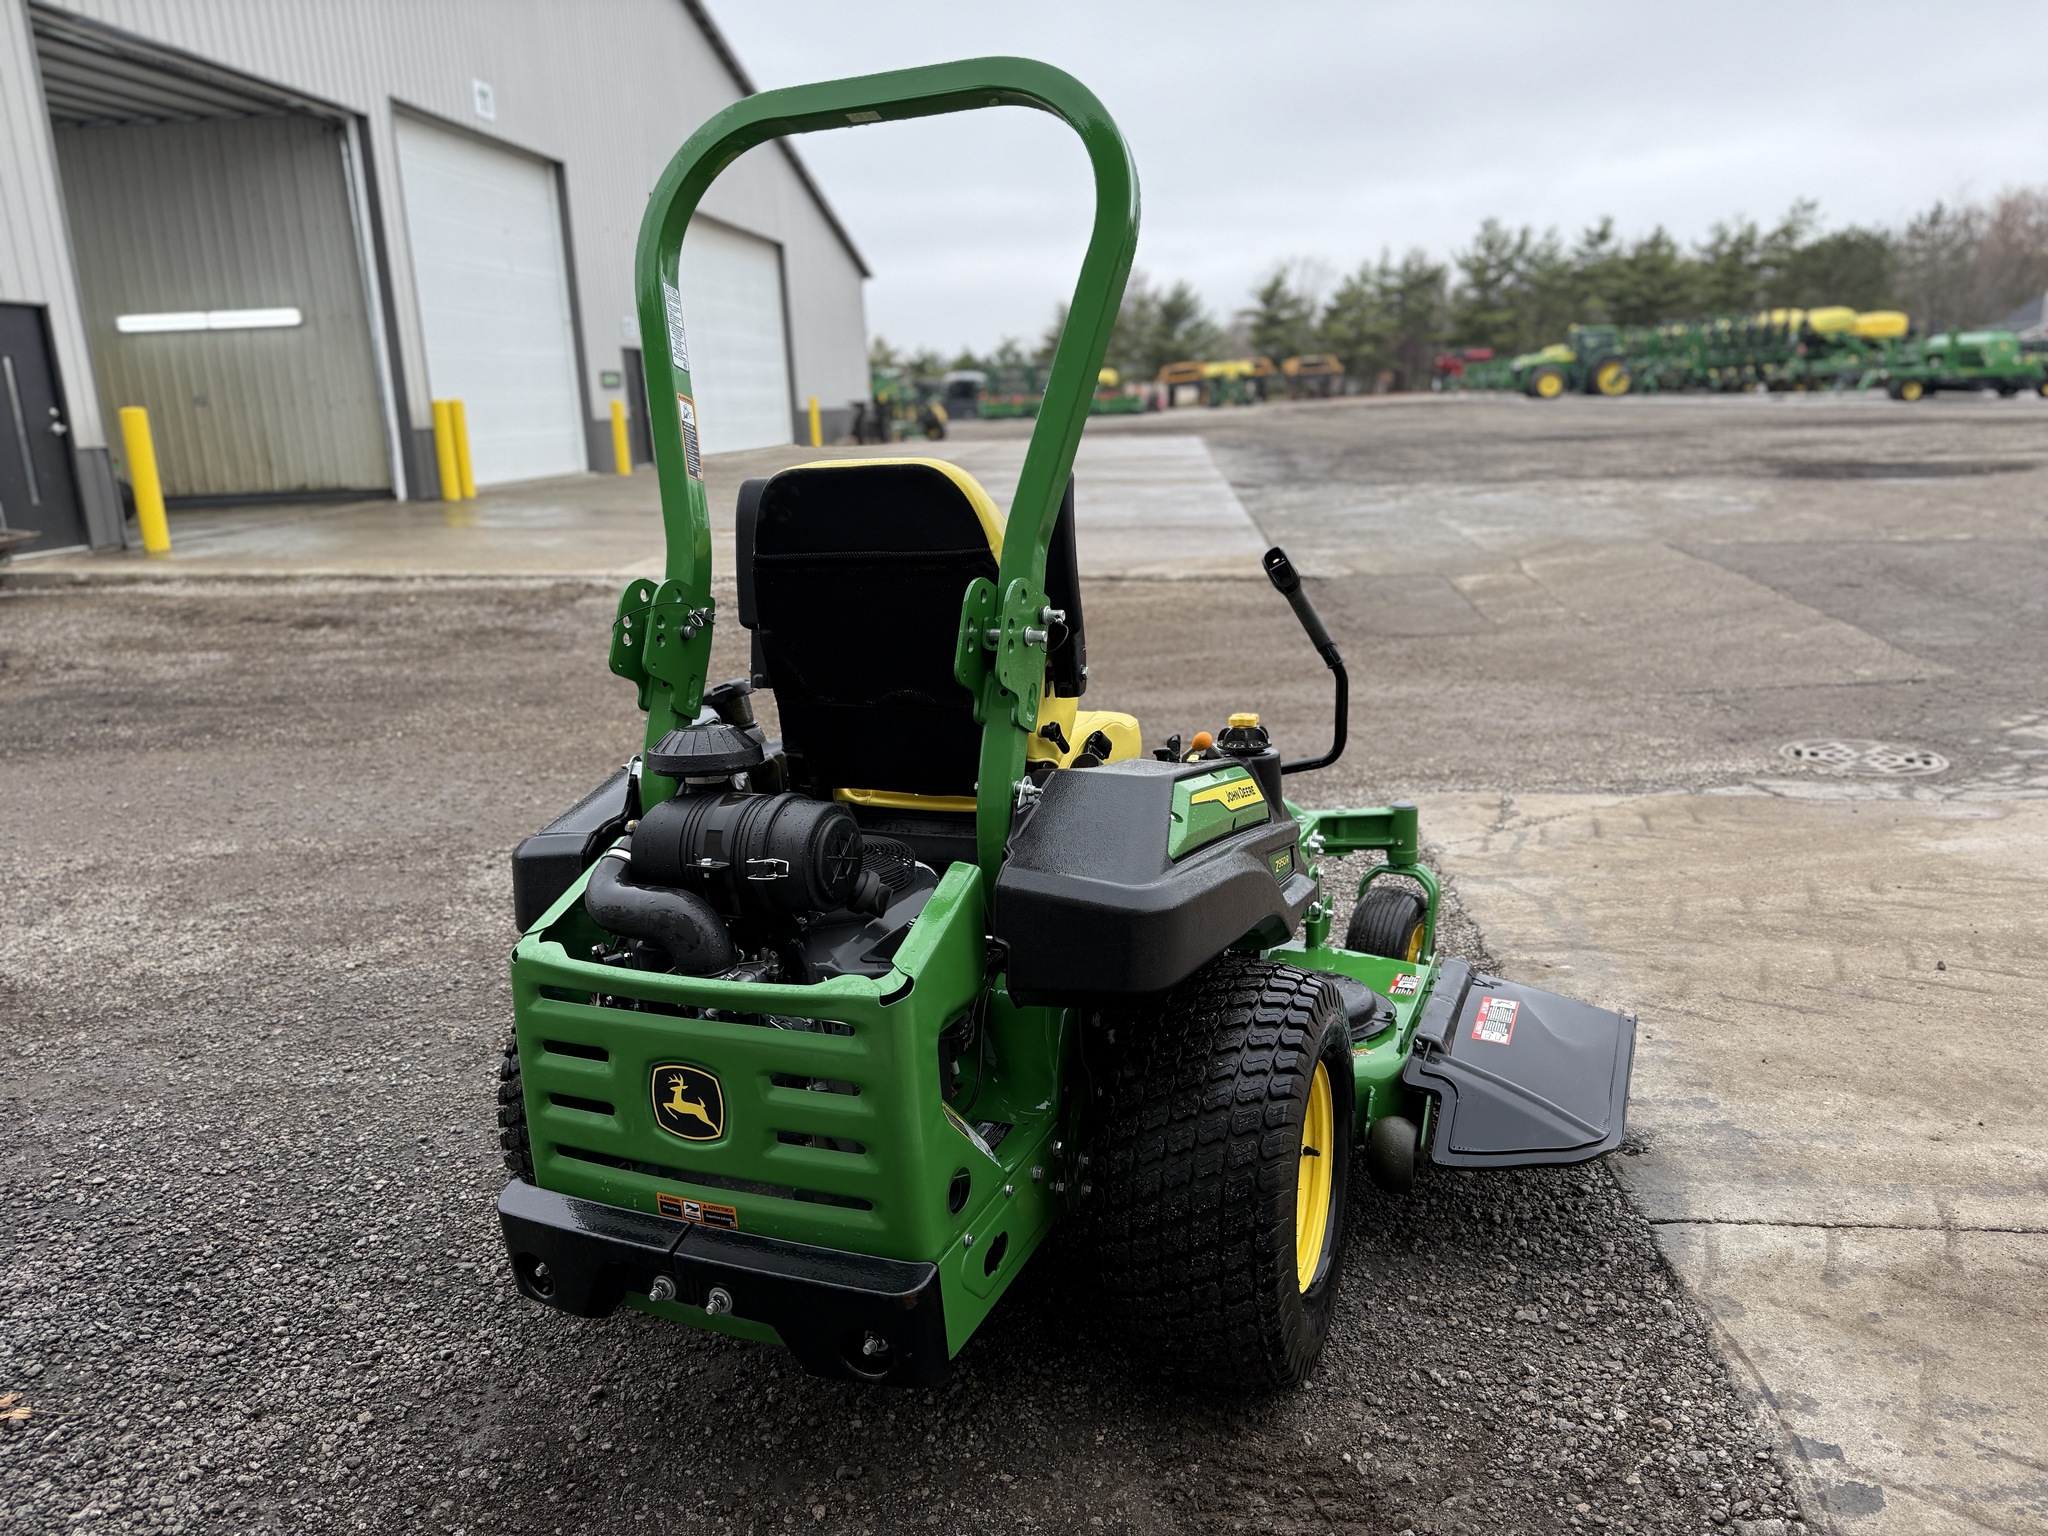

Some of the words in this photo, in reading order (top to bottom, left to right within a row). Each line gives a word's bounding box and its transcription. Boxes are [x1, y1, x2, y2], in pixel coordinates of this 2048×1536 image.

[1225, 789, 1240, 802] JOHN
[1238, 786, 1256, 798] DEERE
[663, 1195, 681, 1204] WARNING
